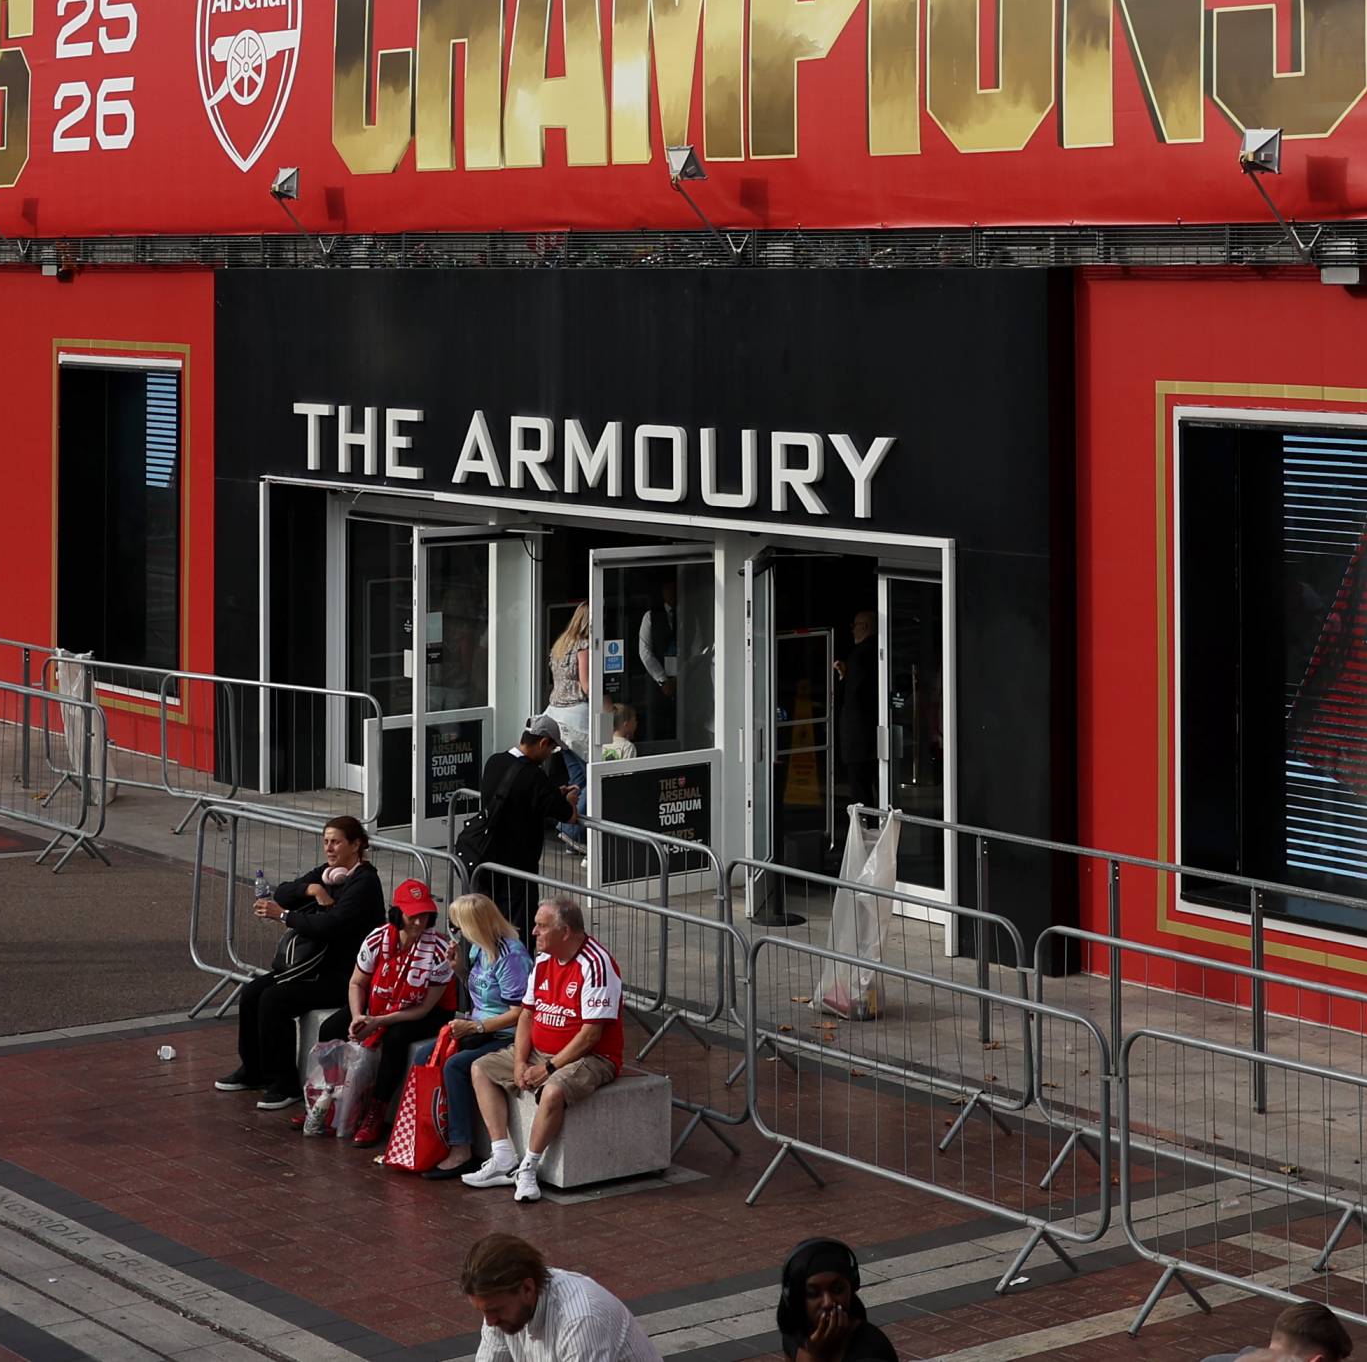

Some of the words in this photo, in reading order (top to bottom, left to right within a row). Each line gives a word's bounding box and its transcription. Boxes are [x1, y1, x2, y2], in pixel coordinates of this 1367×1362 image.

[51, 76, 135, 153] 26
[292, 401, 425, 480] THE
[452, 409, 899, 519] ARMOURY
[432, 752, 473, 767] STADIUM
[432, 765, 457, 777] TOUR
[659, 778, 678, 791] THE
[659, 786, 702, 802] ARSENAL
[659, 798, 702, 815] STADIUM
[659, 813, 685, 826] TOUR
[534, 997, 577, 1018] Emirates
[100, 1249, 214, 1303] CRESCIT
